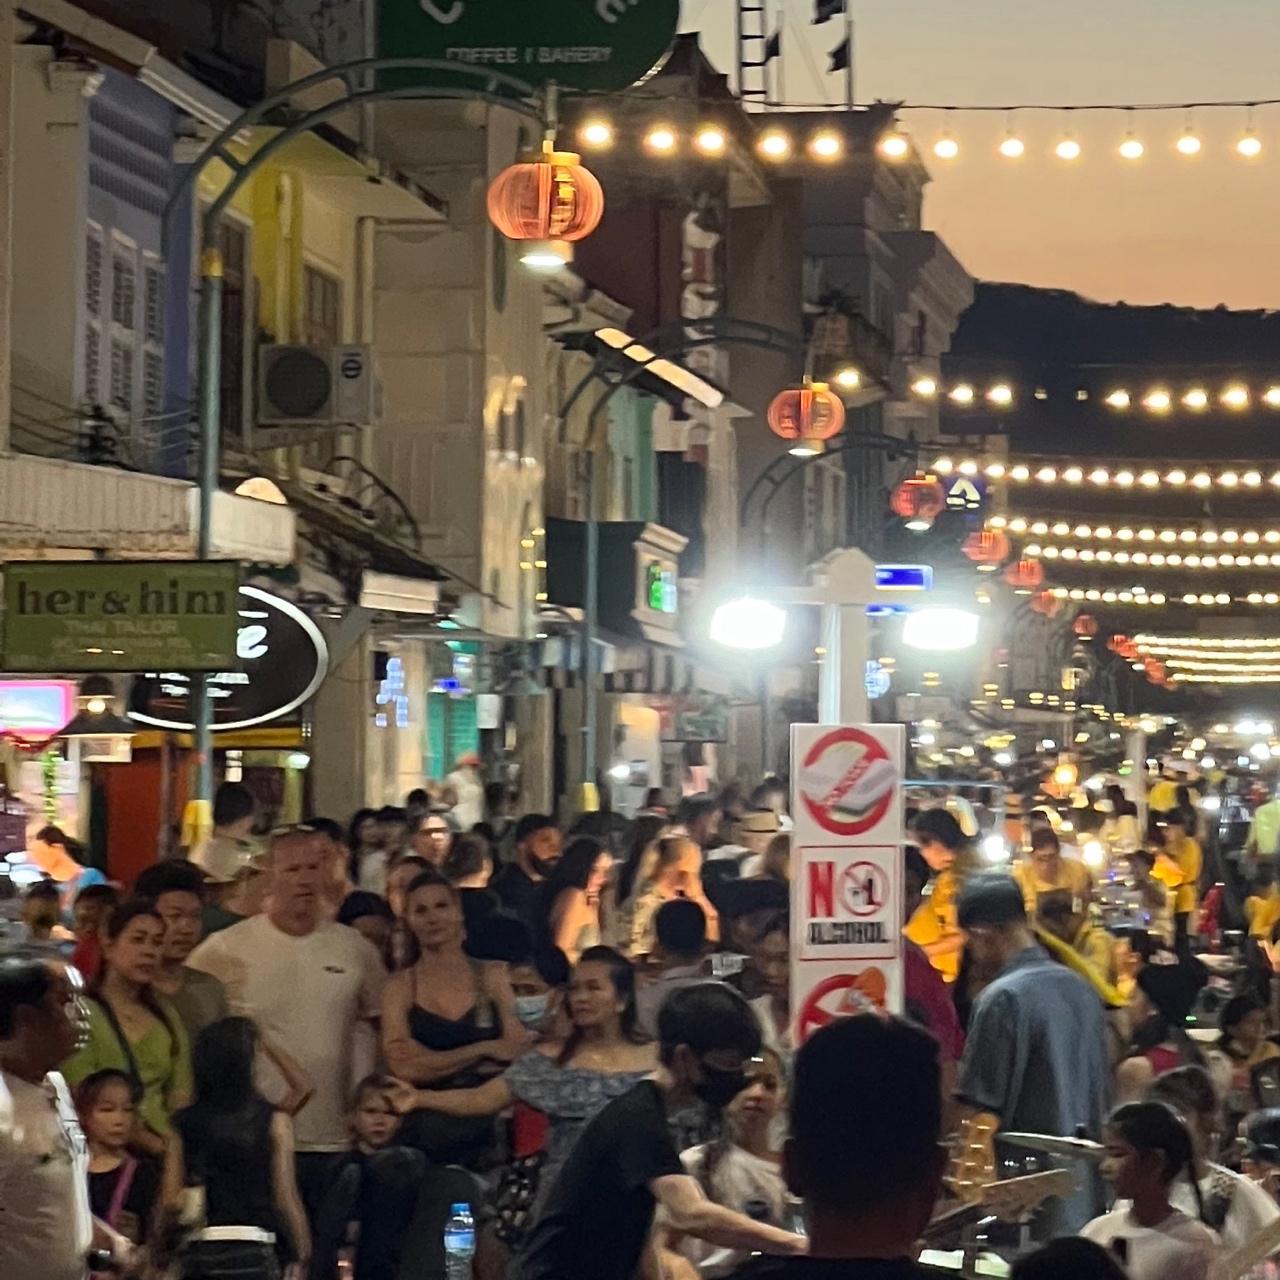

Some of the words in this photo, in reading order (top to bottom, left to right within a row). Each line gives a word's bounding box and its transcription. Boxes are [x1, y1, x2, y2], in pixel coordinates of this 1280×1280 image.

[446, 47, 518, 64] COFFEE
[538, 46, 612, 63] BAKERY
[808, 921, 891, 945] ALCOHOL
